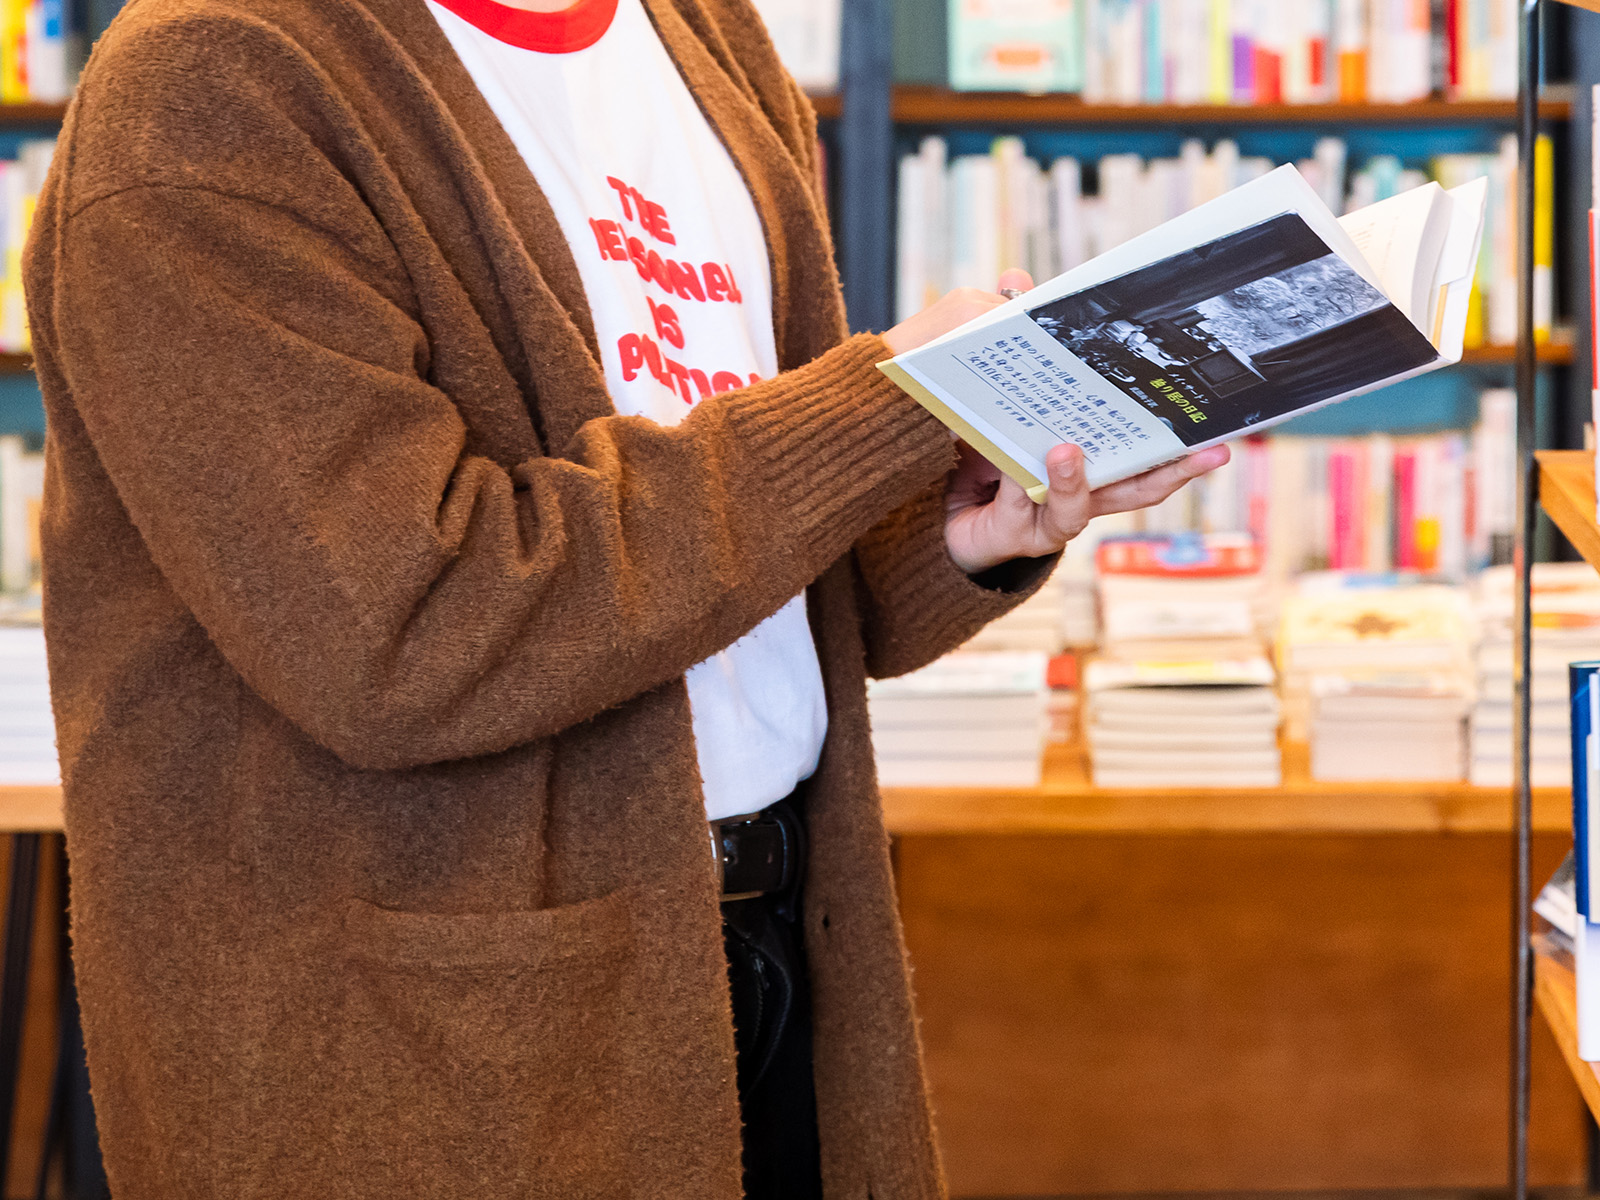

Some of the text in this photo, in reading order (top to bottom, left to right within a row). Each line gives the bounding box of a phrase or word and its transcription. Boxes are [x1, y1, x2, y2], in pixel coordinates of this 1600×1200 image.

[646, 296, 685, 350] IS
[1149, 378, 1208, 424] 独り居の日記
